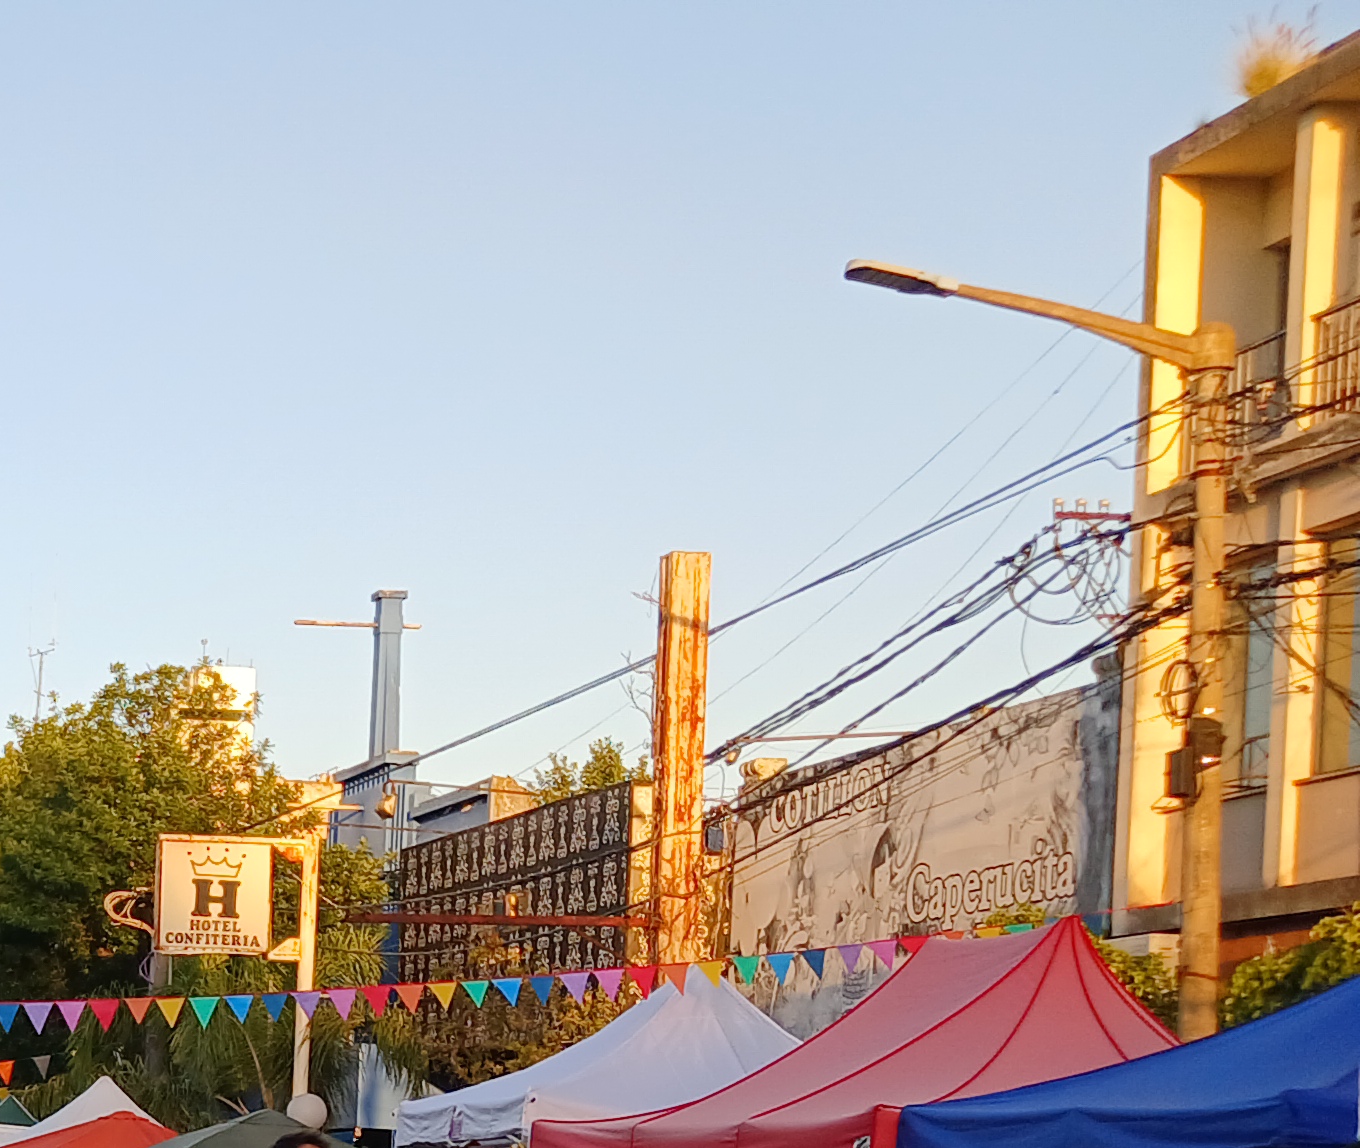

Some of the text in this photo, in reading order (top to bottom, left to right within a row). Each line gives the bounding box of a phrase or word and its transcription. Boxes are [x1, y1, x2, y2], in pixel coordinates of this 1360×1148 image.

[770, 763, 891, 834] COTILLON
[191, 878, 242, 918] H
[906, 837, 1076, 931] Caperucita
[165, 932, 260, 948] CONFITERIA
[190, 919, 241, 932] HOTEL
